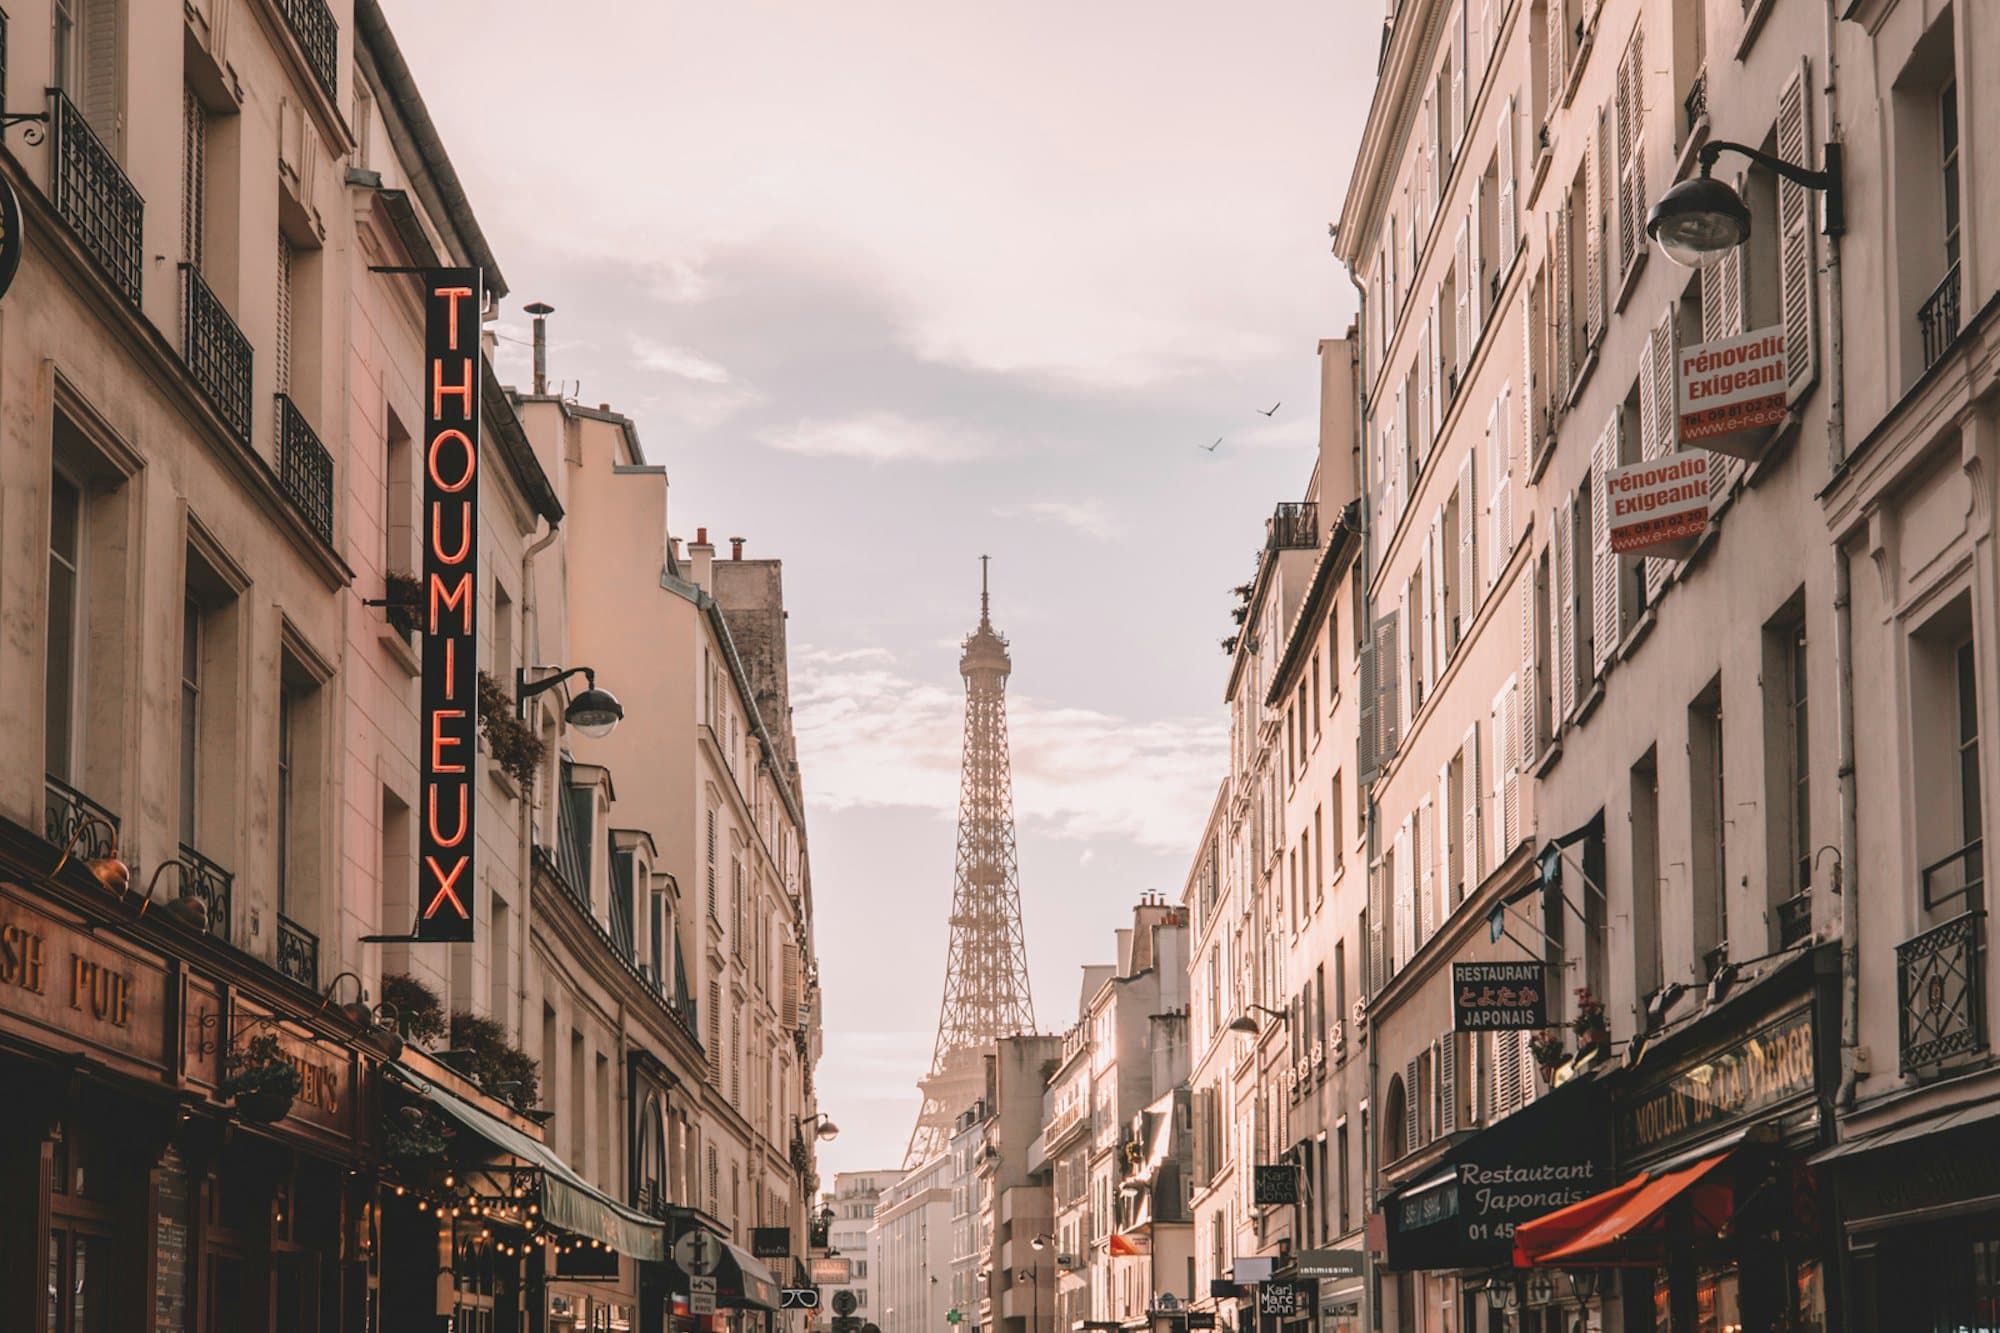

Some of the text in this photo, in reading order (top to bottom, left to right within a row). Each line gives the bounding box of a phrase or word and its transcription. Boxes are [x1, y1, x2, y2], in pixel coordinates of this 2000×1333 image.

[1689, 360, 1786, 400] Exigeant
[1608, 458, 1707, 495] rénovatio
[423, 287, 476, 920] THOUMIEUX
[1455, 966, 1540, 982] RESTAURANT
[70, 952, 134, 1030] PUB
[1459, 986, 1539, 1007] とよたか
[1464, 1010, 1535, 1026] JAPONAIS
[1636, 1083, 1688, 1145] MOULIN
[1693, 1079, 1713, 1124] DE
[1718, 1060, 1744, 1112] LA
[1747, 1023, 1814, 1101] VIERGE
[1263, 1168, 1293, 1181] Karl
[1459, 1159, 1595, 1185] Restaurant
[1256, 1179, 1294, 1192] Marc
[1258, 1188, 1294, 1201] John
[1475, 1186, 1583, 1216] Japonais
[1468, 1222, 1515, 1240] 01 45
[1300, 1266, 1354, 1274] intimissimi
[1266, 1283, 1294, 1295] Karl
[1261, 1293, 1294, 1305] Marc
[1262, 1303, 1294, 1314] John
